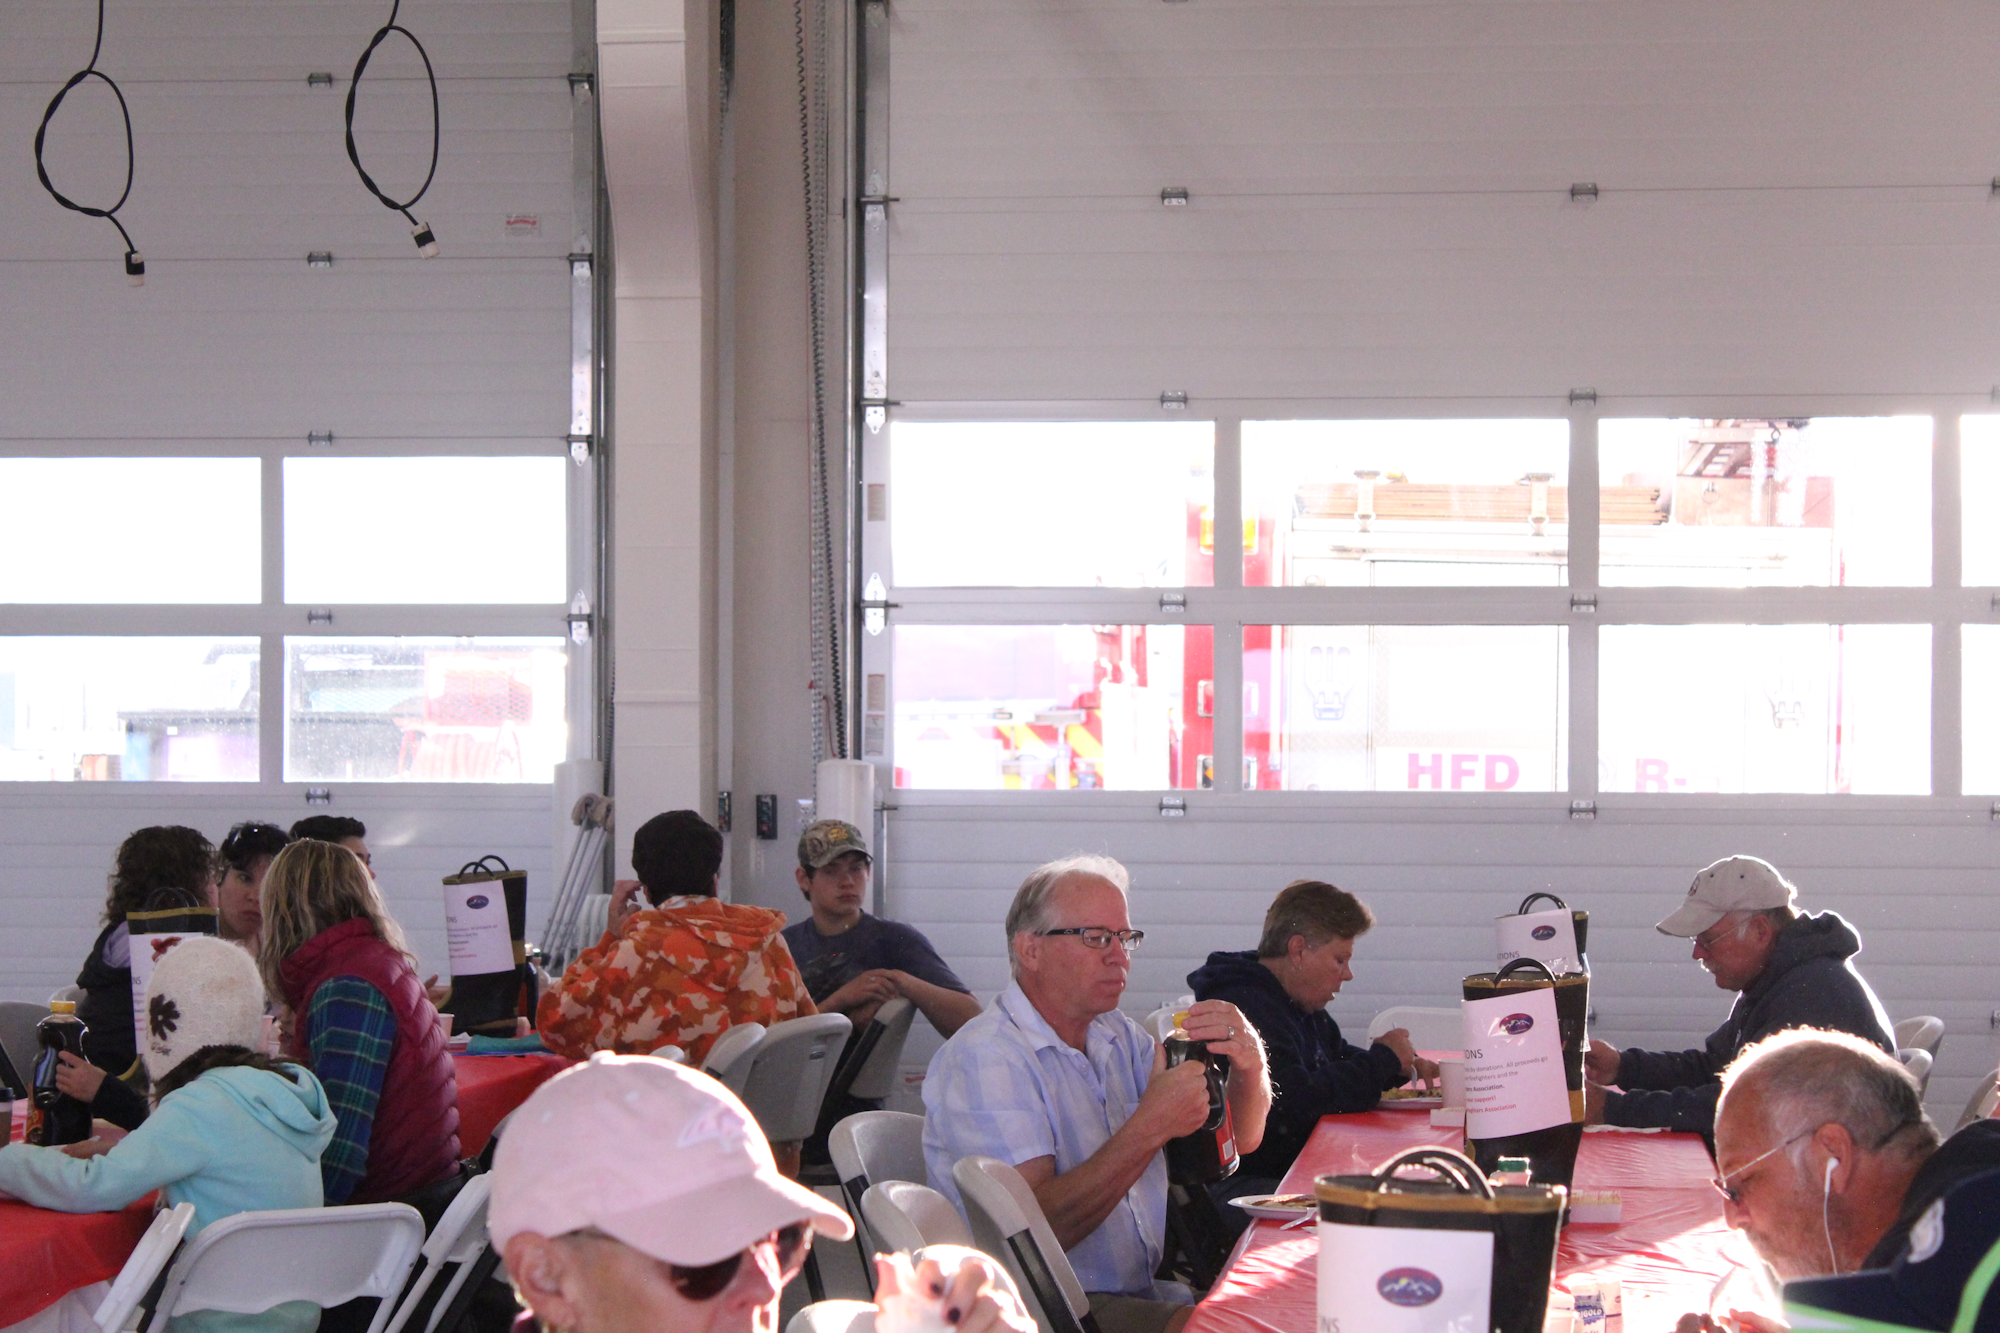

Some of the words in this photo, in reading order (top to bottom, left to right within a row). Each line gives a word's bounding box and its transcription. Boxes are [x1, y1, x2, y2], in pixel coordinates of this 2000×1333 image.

[1407, 753, 1520, 790] HFD
[1635, 758, 1721, 792] R-
[1464, 1049, 1483, 1059] ONS
[1515, 1057, 1540, 1067] proceeds
[1484, 1104, 1517, 1112] Association
